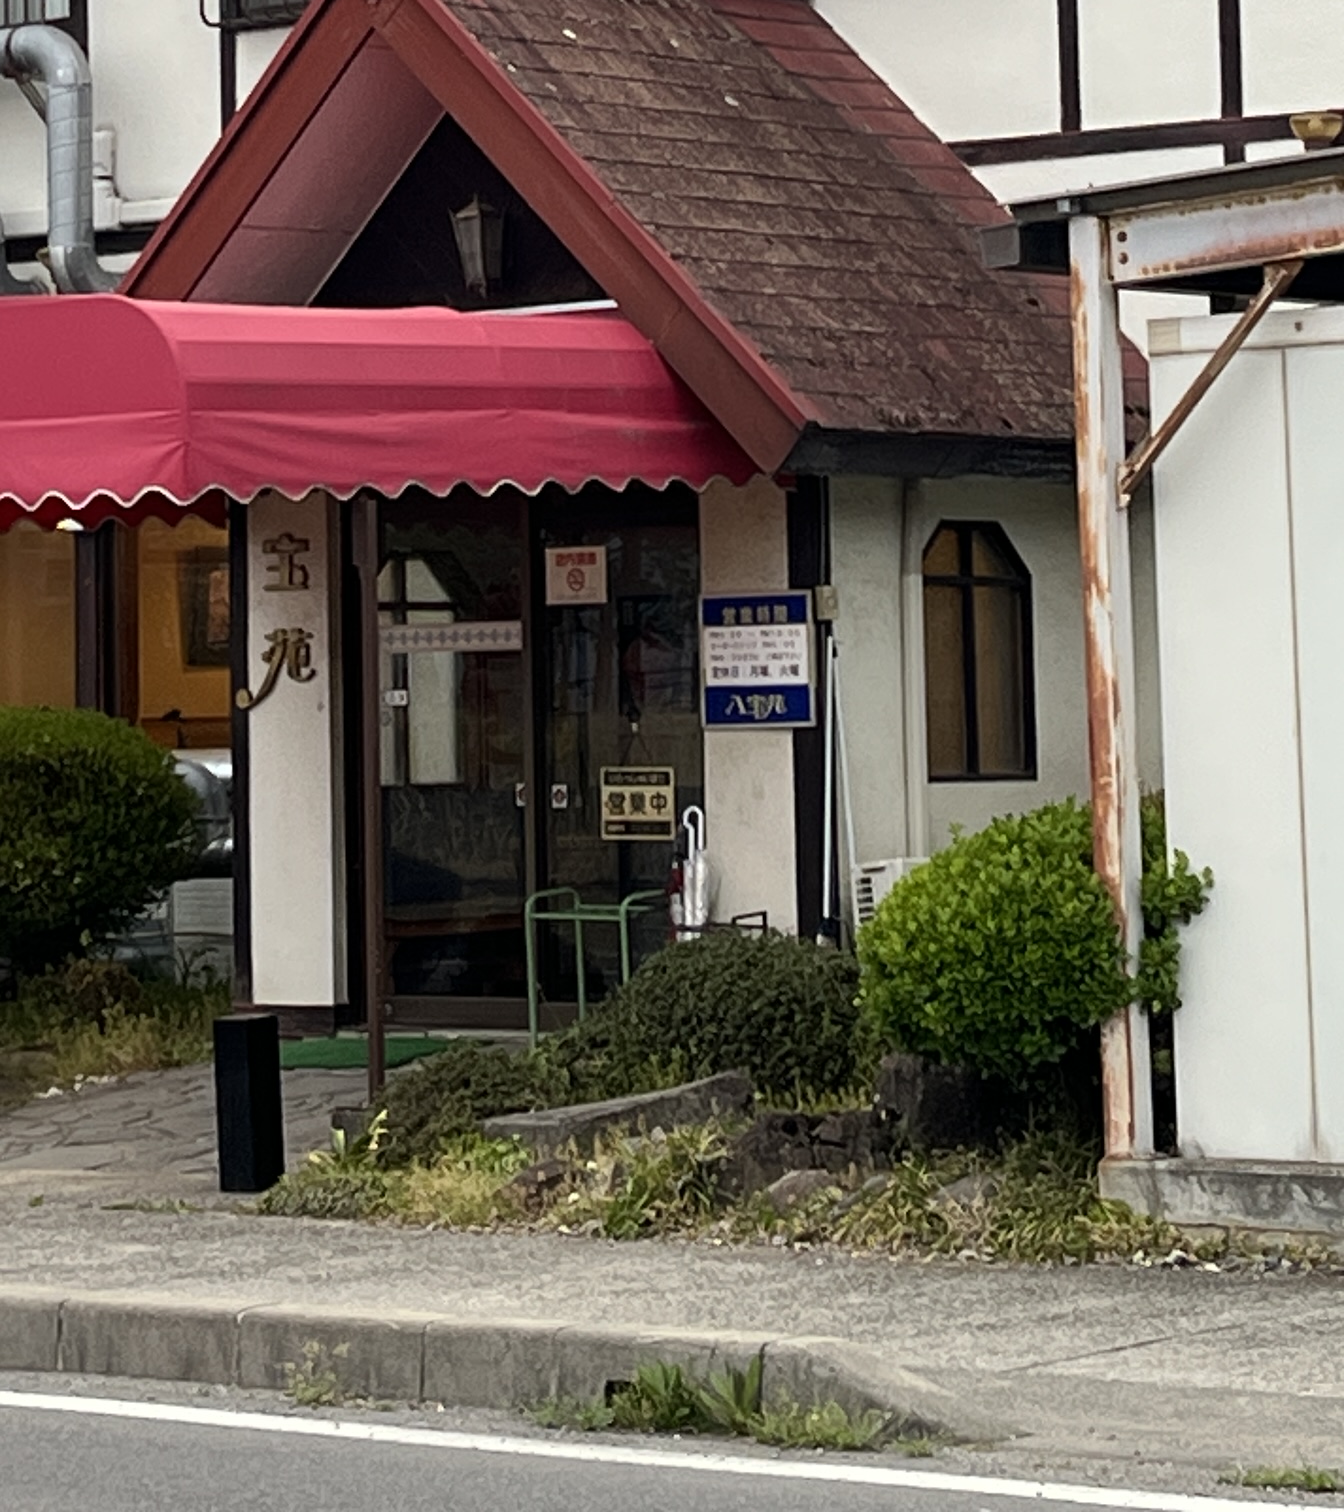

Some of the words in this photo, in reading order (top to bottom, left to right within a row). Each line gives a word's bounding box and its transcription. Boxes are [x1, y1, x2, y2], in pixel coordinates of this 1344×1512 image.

[236, 533, 316, 710] 宝苑
[608, 791, 668, 816] 営業中
